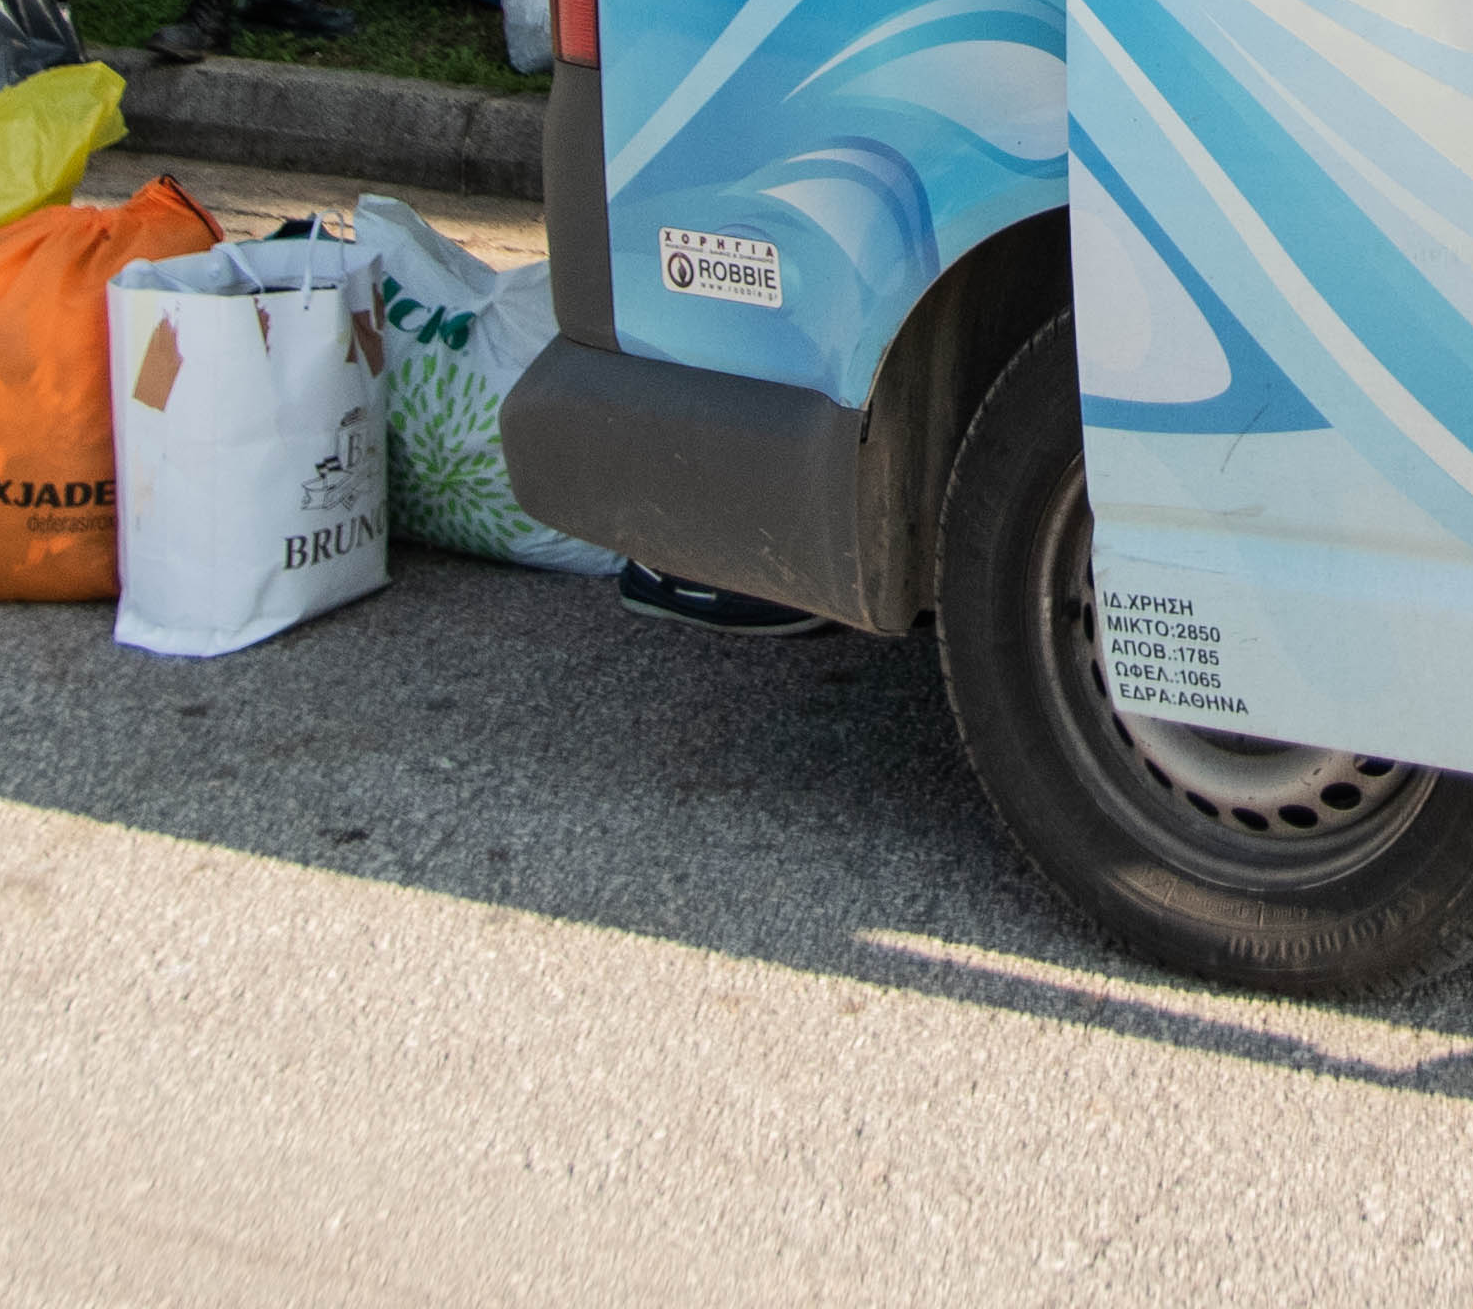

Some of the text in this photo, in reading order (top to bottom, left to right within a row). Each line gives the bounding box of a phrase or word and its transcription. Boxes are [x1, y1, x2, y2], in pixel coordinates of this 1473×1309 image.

[664, 230, 775, 258] ΧΟΡΗΓΙΑ
[698, 258, 777, 290] ROBBIE
[1102, 590, 1194, 617] ΙΔ.ΧΡΗΣΗ
[1106, 614, 1221, 643] ΜΙΚΤΟ:2850
[1111, 638, 1220, 666] ΑΠΟΒ.:1785
[1115, 660, 1222, 689] ΩΦΕΛ.:1065
[1119, 682, 1250, 716] ΕΔΡΑ:ΑΘΗΝΑ
